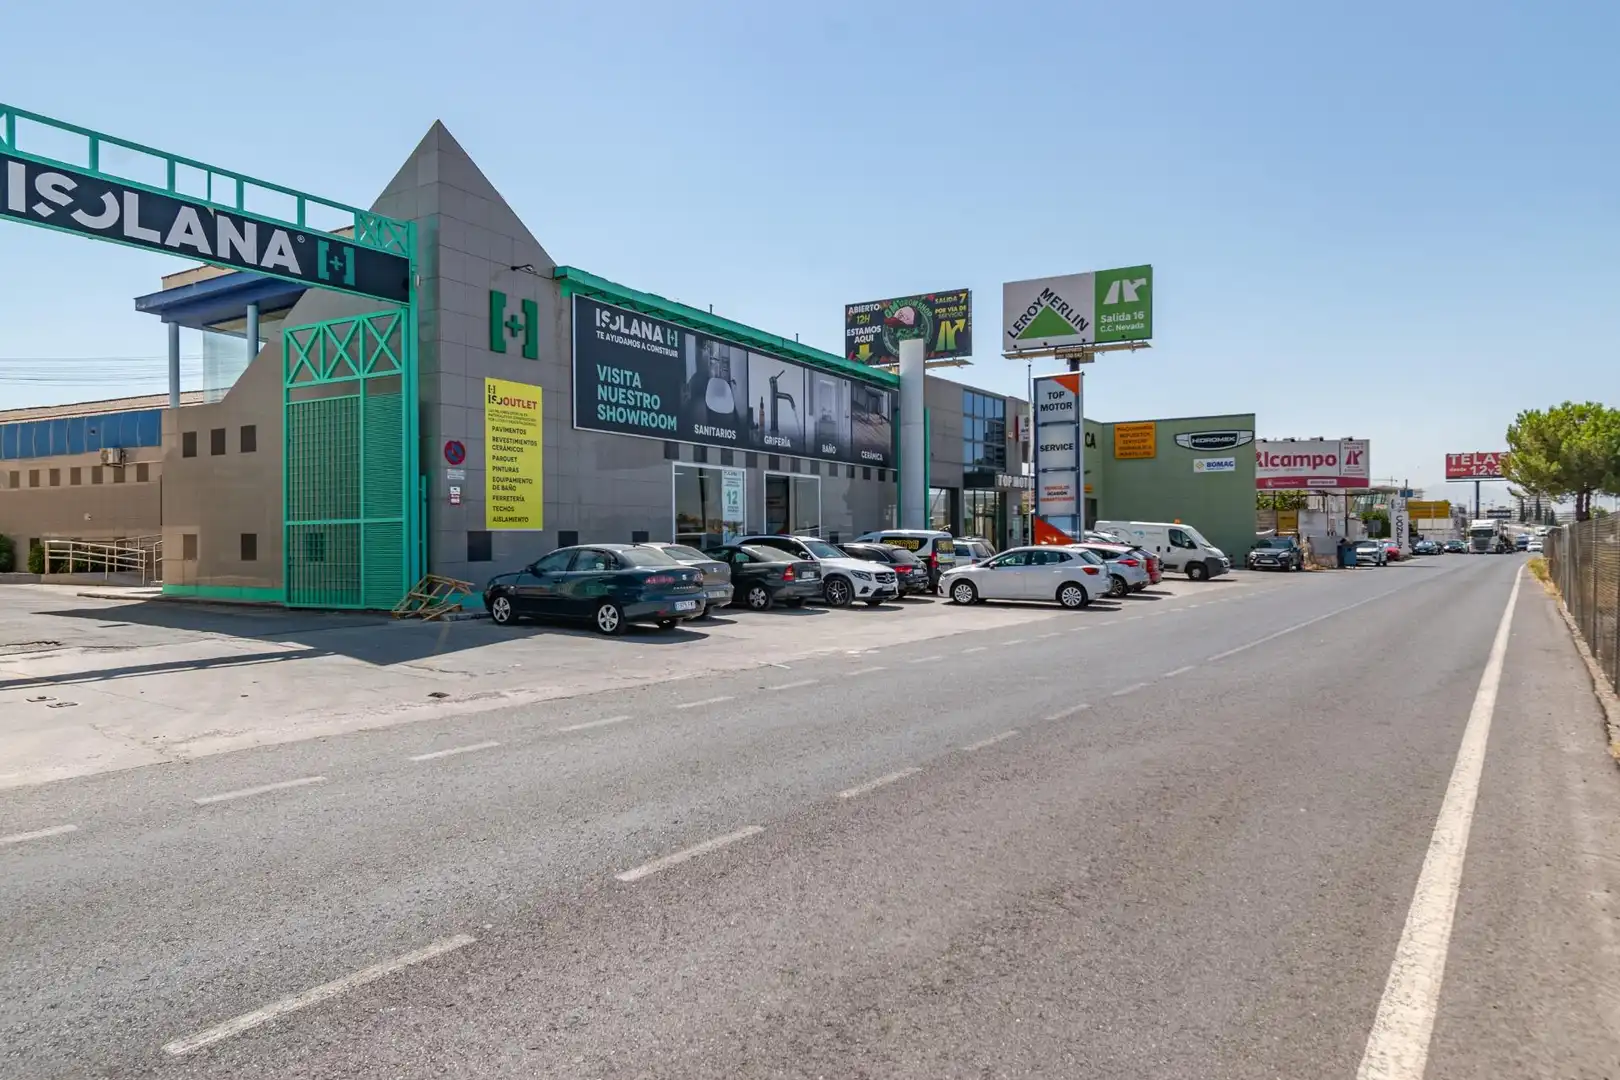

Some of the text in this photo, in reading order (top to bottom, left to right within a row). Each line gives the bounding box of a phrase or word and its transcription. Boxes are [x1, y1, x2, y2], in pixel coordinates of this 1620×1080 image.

[935, 293, 967, 304] SALIDA 7
[848, 303, 880, 314] ABIERTO
[1040, 287, 1089, 332] MERLIN
[856, 314, 871, 324] 12H
[1008, 297, 1044, 339] LEROY
[1101, 311, 1145, 323] Salida 16
[846, 325, 882, 336] ESTAMOS
[1100, 322, 1144, 333] C.C. Nevada
[596, 330, 679, 359] TE AYUDAMOS A CONSTRUIR
[596, 364, 642, 389] VISITA
[597, 384, 661, 410] NUESTRO
[1047, 391, 1065, 400] TOP
[1040, 401, 1073, 412] MOTOR
[597, 403, 677, 431] SHOWROOM
[492, 425, 527, 435] PAVIMENTOS
[694, 424, 736, 440] SANITARIOS
[492, 436, 538, 447] REVESTIMIENTOS
[764, 435, 791, 448] GRIFERÍA
[822, 444, 836, 454] BAÑO
[1039, 442, 1074, 453] SERVICE
[492, 454, 518, 463] PARQUET
[1448, 453, 1508, 466] TELAS
[492, 465, 519, 473] PINTURAS
[492, 476, 533, 485] EQUIPAMIENTO
[997, 474, 1012, 487] TOP
[501, 484, 517, 492] BAÑO
[726, 490, 738, 505] 12
